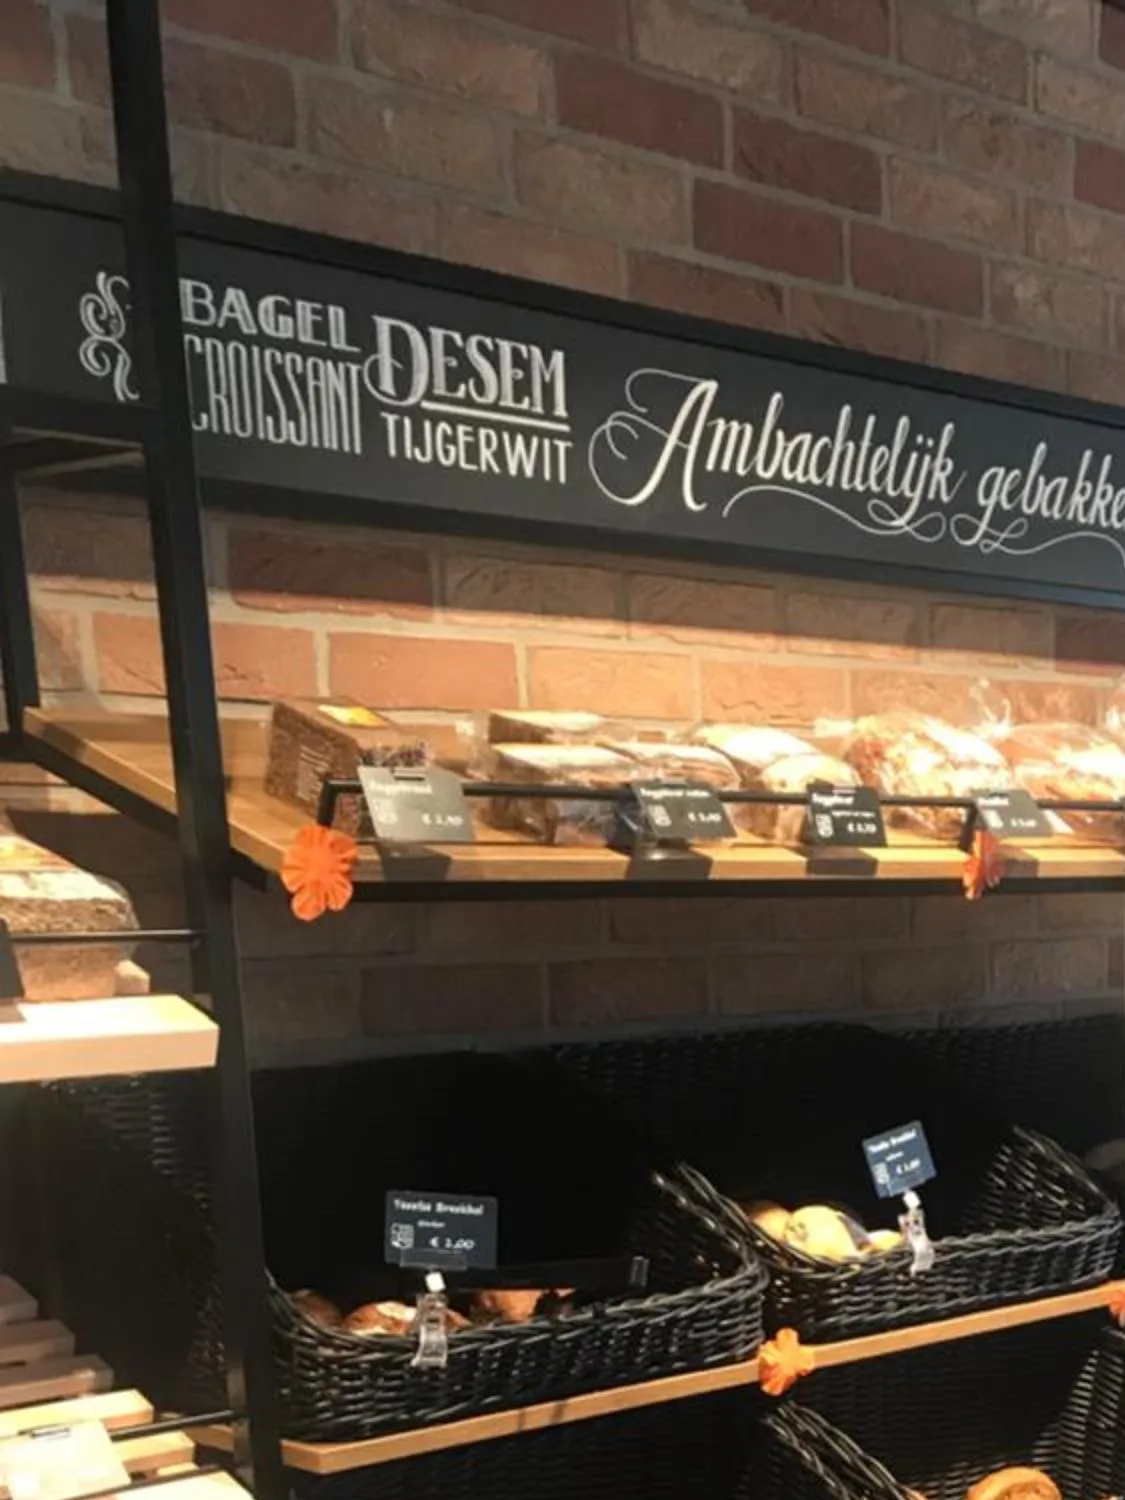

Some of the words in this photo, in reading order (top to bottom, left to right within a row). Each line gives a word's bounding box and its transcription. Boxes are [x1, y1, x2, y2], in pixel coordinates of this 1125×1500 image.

[179, 277, 361, 353] BAGEL
[363, 314, 569, 420] DESEM
[184, 333, 363, 455] CROISSANT
[380, 411, 574, 484] TIJGERWIT
[589, 368, 968, 541] Ambachtelijk
